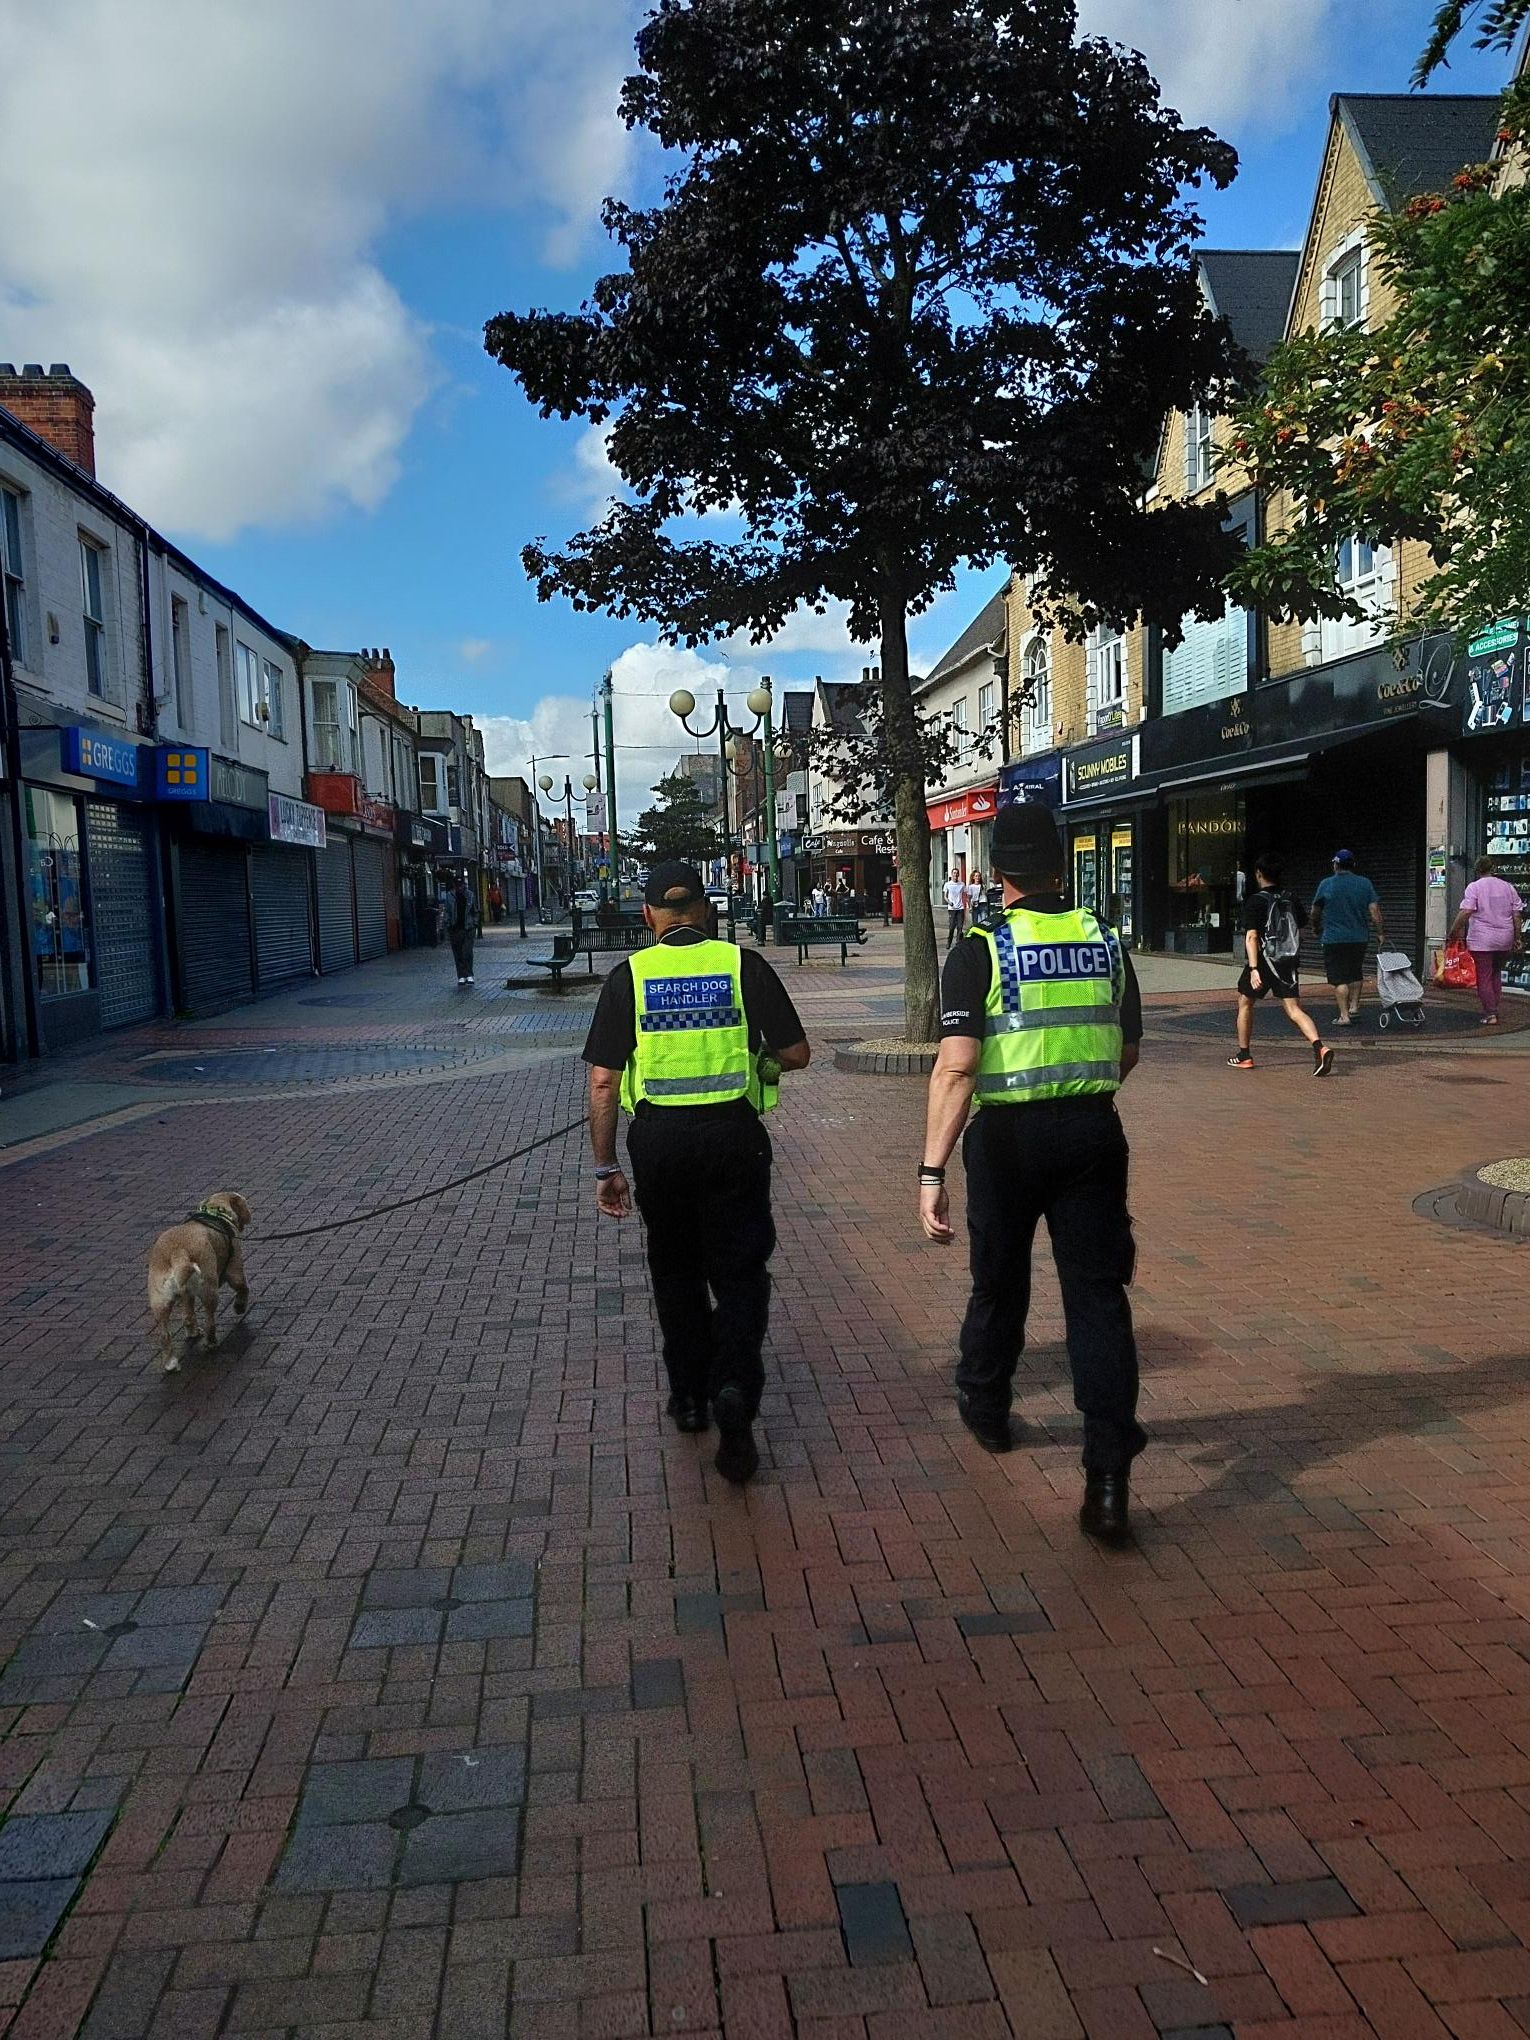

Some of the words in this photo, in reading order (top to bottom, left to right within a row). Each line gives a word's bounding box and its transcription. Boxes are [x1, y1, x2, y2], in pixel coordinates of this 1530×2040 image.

[1475, 633, 1518, 652] ACCESSORIES
[1221, 721, 1250, 740] Coe&Co
[93, 742, 135, 777] GREGGS
[1077, 761, 1100, 781] SCUNNY
[1100, 753, 1127, 775] MOBILES
[168, 787, 197, 796] GREGGS
[1012, 783, 1045, 792] AMIRAL
[949, 802, 968, 820] Santander
[861, 835, 883, 846] Cafe
[886, 836, 894, 844] &
[1021, 948, 1107, 976] POLICE
[649, 982, 698, 994] SEARCH
[701, 980, 728, 992] DOG
[661, 993, 718, 1005] HANDLER
[941, 1010, 970, 1020] MBERSIDE
[943, 1018, 960, 1026] POLICE
